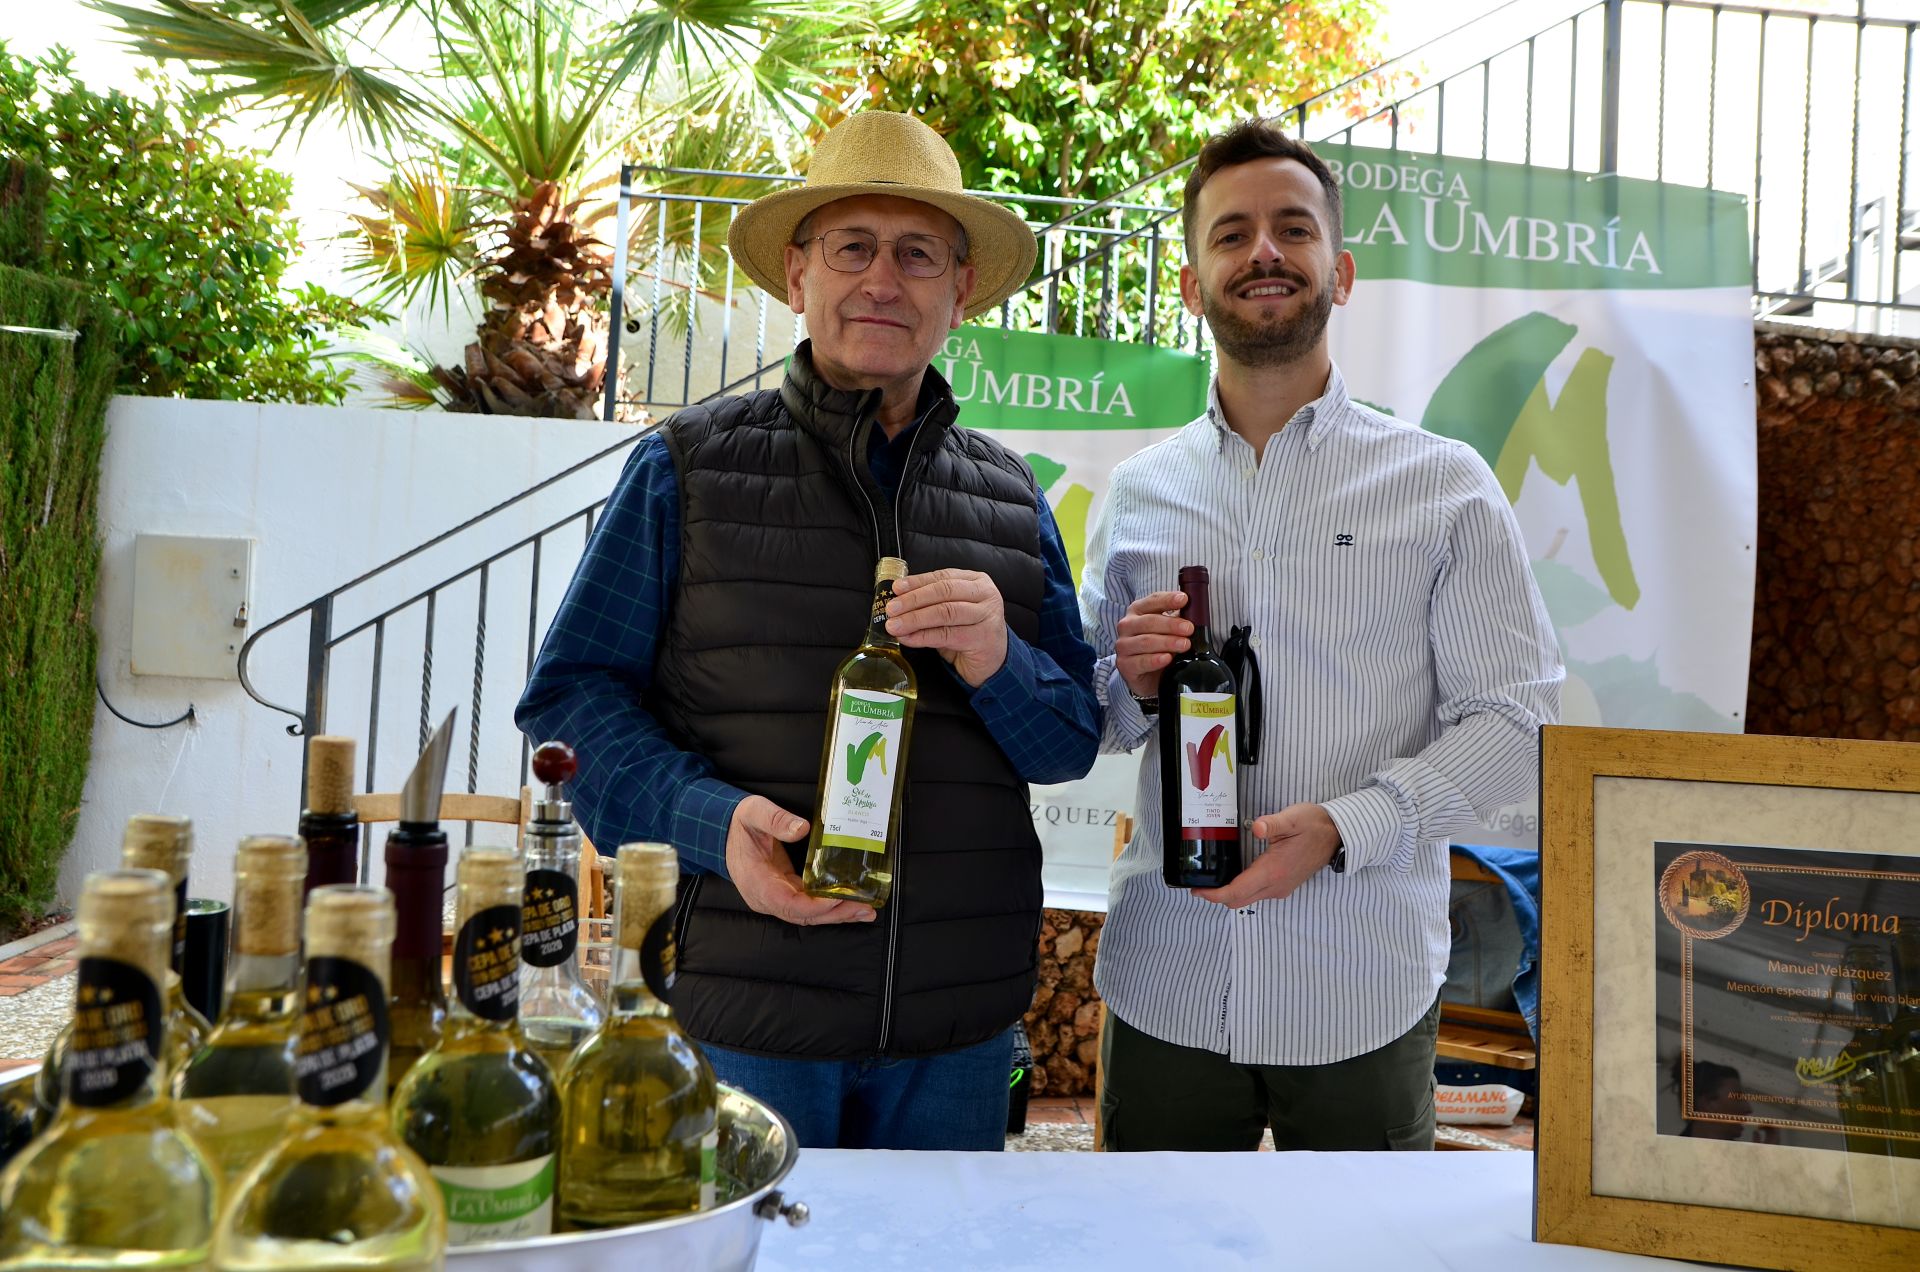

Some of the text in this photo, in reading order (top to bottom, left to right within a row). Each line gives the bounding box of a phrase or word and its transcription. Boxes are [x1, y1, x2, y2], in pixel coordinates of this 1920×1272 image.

[1326, 158, 1471, 199] BODEGA
[1422, 196, 1662, 275] UMBRÍA
[941, 358, 1136, 418] UMBRÍA
[1760, 897, 1901, 942] Diploma
[1767, 960, 1893, 982] Manuel Velázquez
[1727, 981, 1774, 994] Mención
[1775, 985, 1820, 999] especial
[1823, 987, 1832, 997] al
[1835, 991, 1867, 1002] mejor
[1870, 993, 1895, 1004] vino
[1727, 1091, 1784, 1105] AYUNTAMIENTO
[1785, 1098, 1796, 1106] DE
[1830, 1102, 1849, 1110] VEGA
[1856, 1103, 1893, 1114] GRANADA
